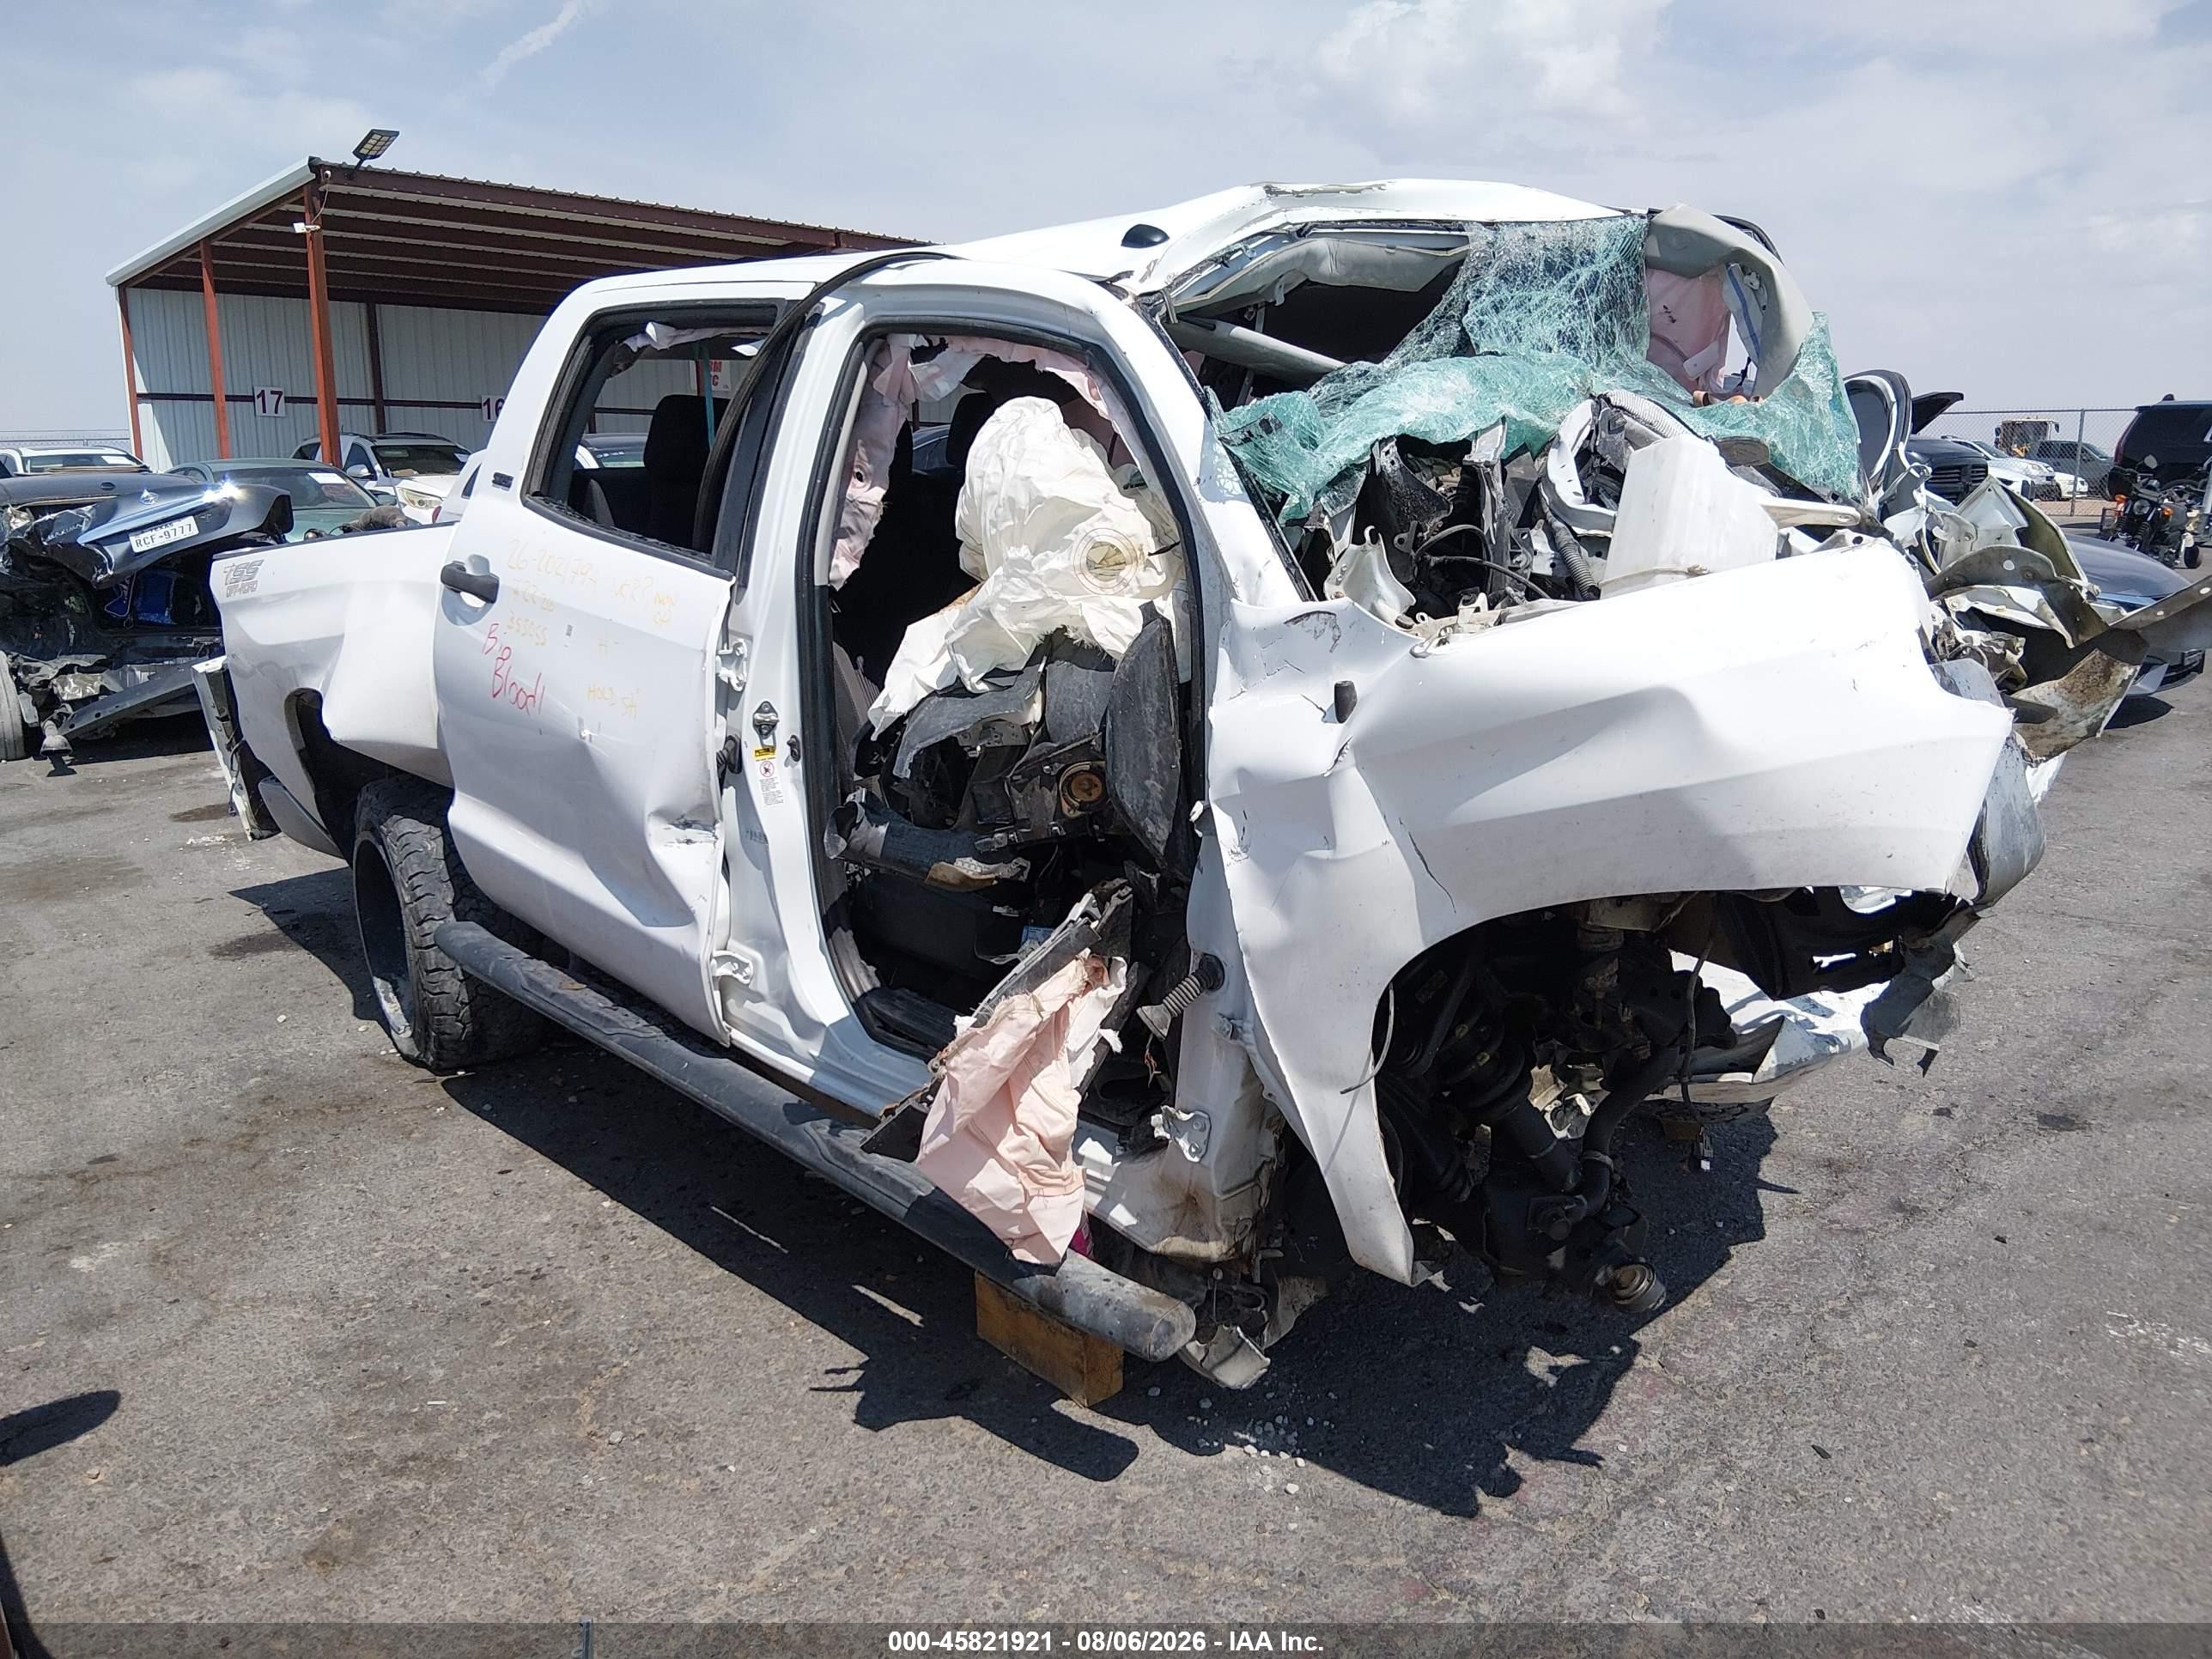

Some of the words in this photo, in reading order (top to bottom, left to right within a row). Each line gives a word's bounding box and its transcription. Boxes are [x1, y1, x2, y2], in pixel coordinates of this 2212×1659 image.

[257, 389, 283, 414] 17
[135, 523, 192, 548] RCF-9777
[224, 560, 264, 586] TSS
